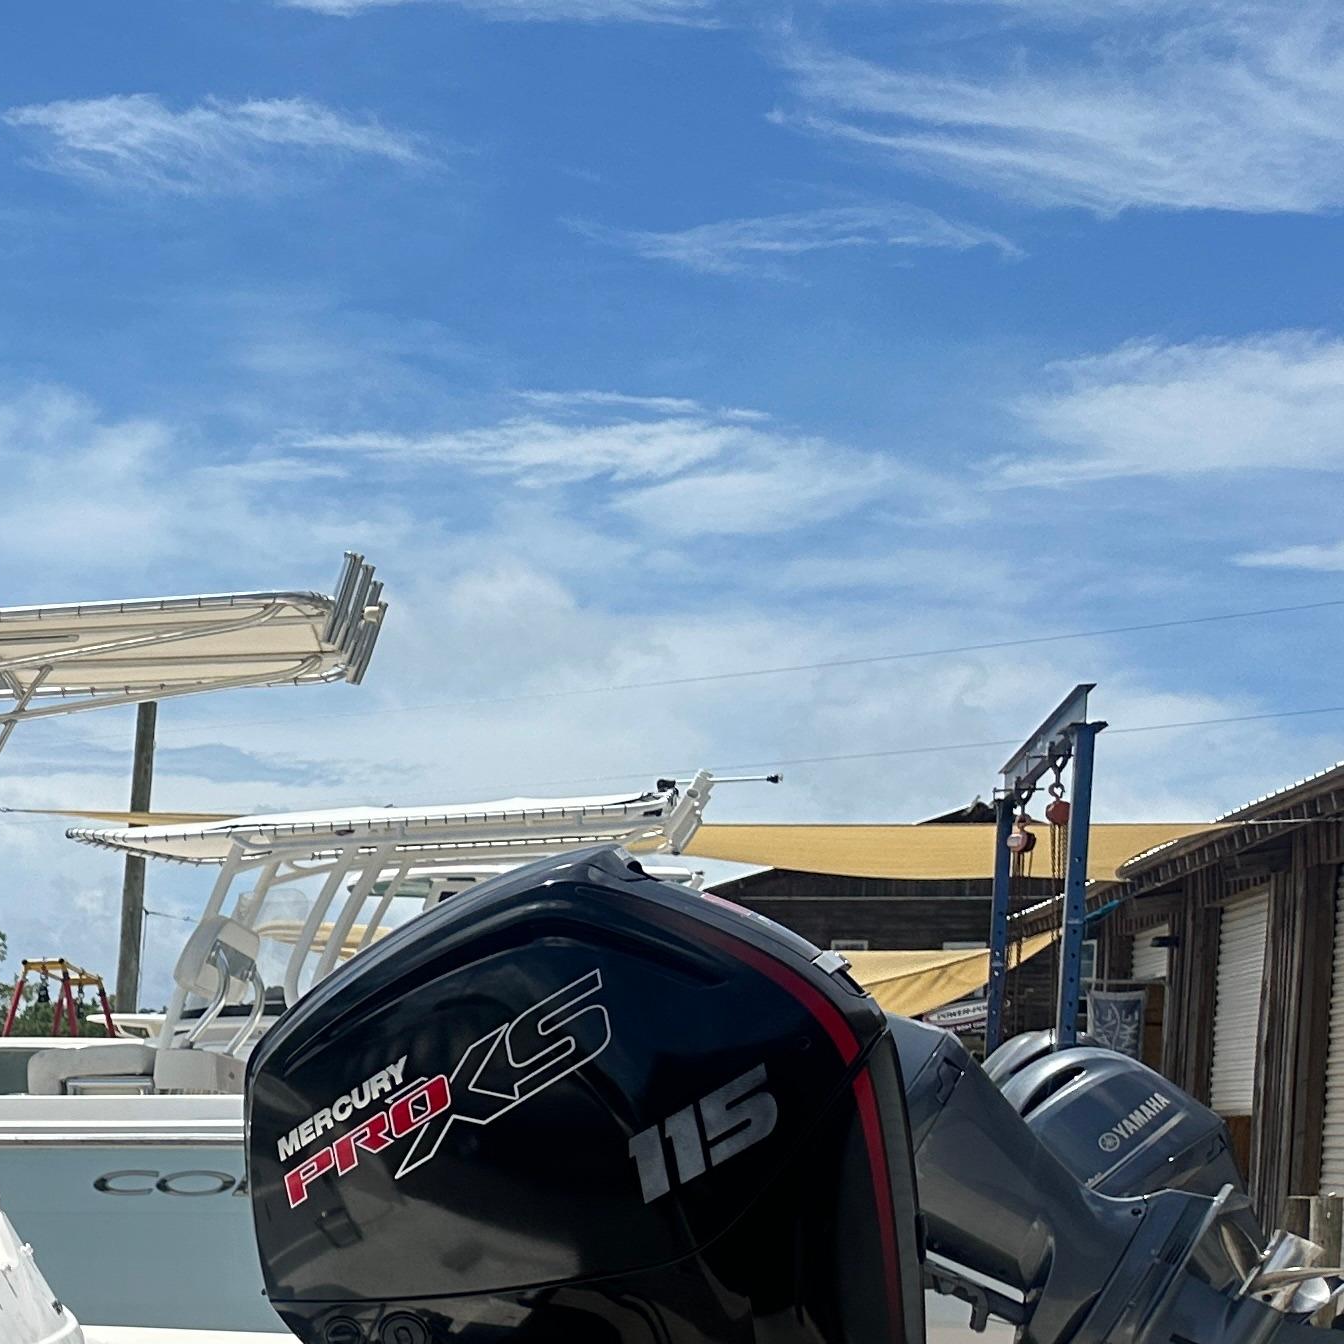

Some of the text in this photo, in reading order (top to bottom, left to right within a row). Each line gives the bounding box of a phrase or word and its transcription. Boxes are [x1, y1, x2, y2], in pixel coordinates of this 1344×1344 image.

[277, 1054, 408, 1161] MERCURY
[284, 1074, 451, 1208] PRO
[628, 1062, 778, 1204] 115
[1112, 1092, 1171, 1139] YAMAHA
